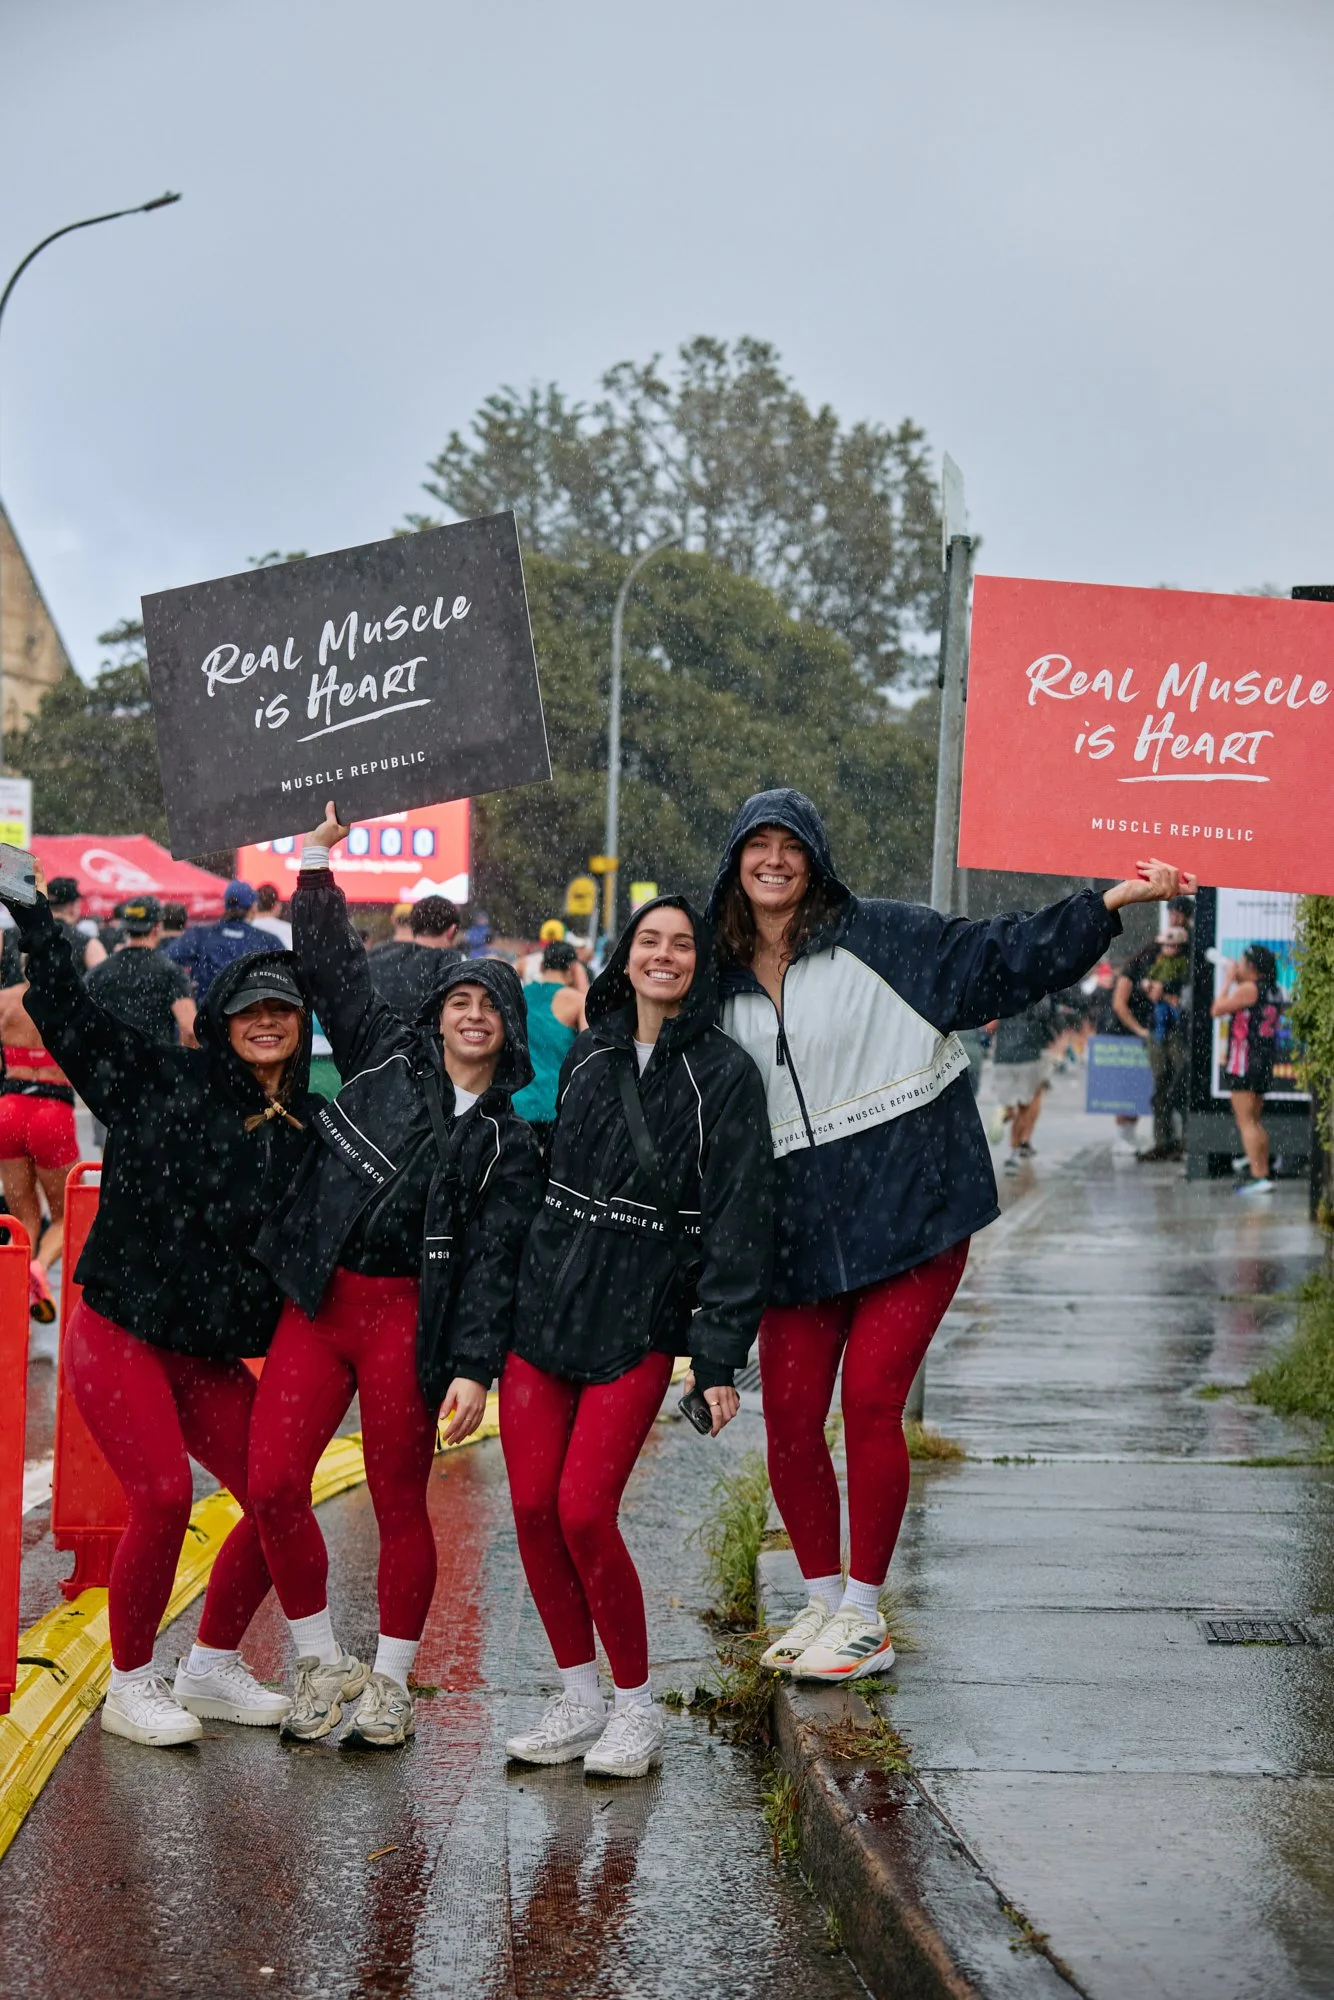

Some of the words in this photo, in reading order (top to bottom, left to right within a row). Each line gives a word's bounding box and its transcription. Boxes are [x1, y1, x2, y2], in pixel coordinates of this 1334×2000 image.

[281, 769, 344, 792] MUSCLE
[351, 751, 427, 777] REPUBLIC
[1091, 817, 1162, 834] MUSCLE
[1170, 823, 1254, 841] REPUBLIC
[259, 971, 288, 984] REPUBLIC
[847, 1103, 886, 1124] MUSCLE
[890, 1082, 934, 1107] REPUBLIC
[361, 1161, 385, 1184] MSCR
[610, 1211, 648, 1227] MUSCLE
